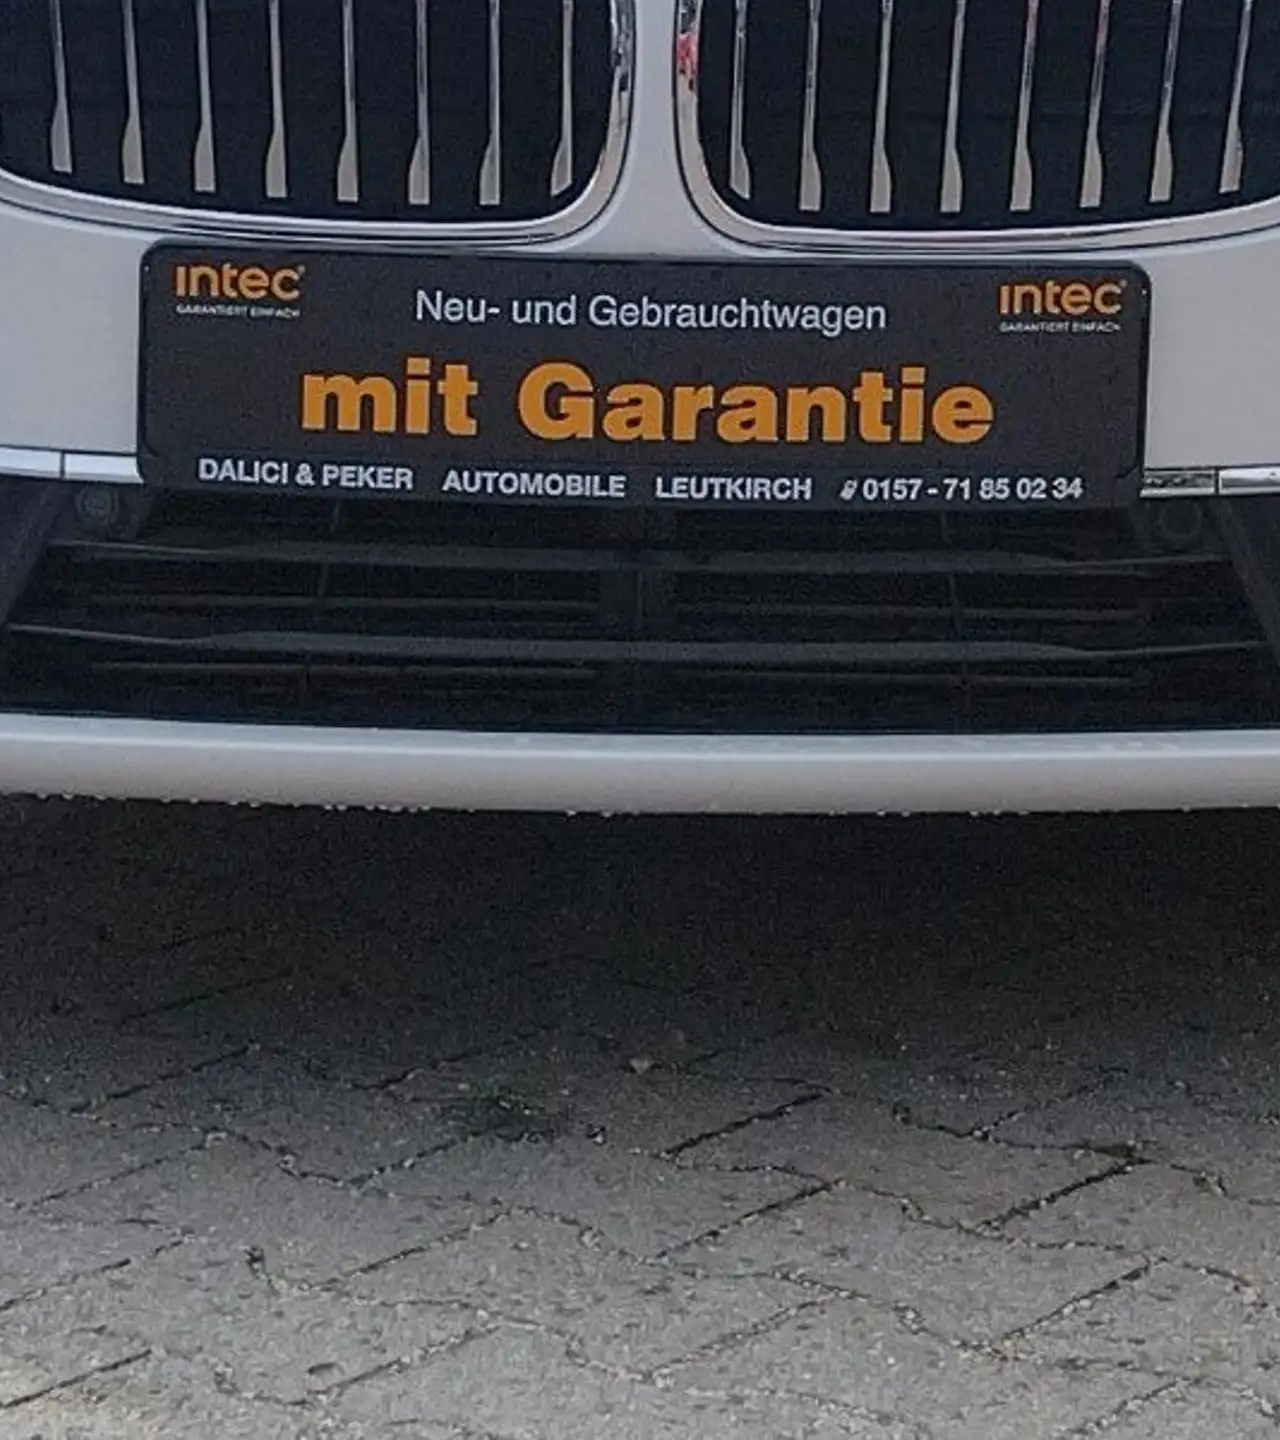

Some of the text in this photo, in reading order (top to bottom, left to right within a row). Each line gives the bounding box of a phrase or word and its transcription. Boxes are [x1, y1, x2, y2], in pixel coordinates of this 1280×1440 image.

[176, 263, 300, 301] intec
[999, 280, 1122, 315] intec
[414, 290, 887, 336] Neu- und Gebrauchtwagen
[301, 357, 995, 444] mit Garantie
[198, 458, 289, 485] DALICI
[294, 463, 315, 487] &
[322, 464, 414, 490] PEKER
[442, 469, 626, 498] AUTOMOBILE
[655, 476, 812, 502] LEUTKIRCH
[863, 477, 923, 502] 0157
[943, 477, 971, 501] 71
[978, 477, 1009, 501] 85
[1016, 476, 1048, 501] 02
[1052, 476, 1084, 500] 34
